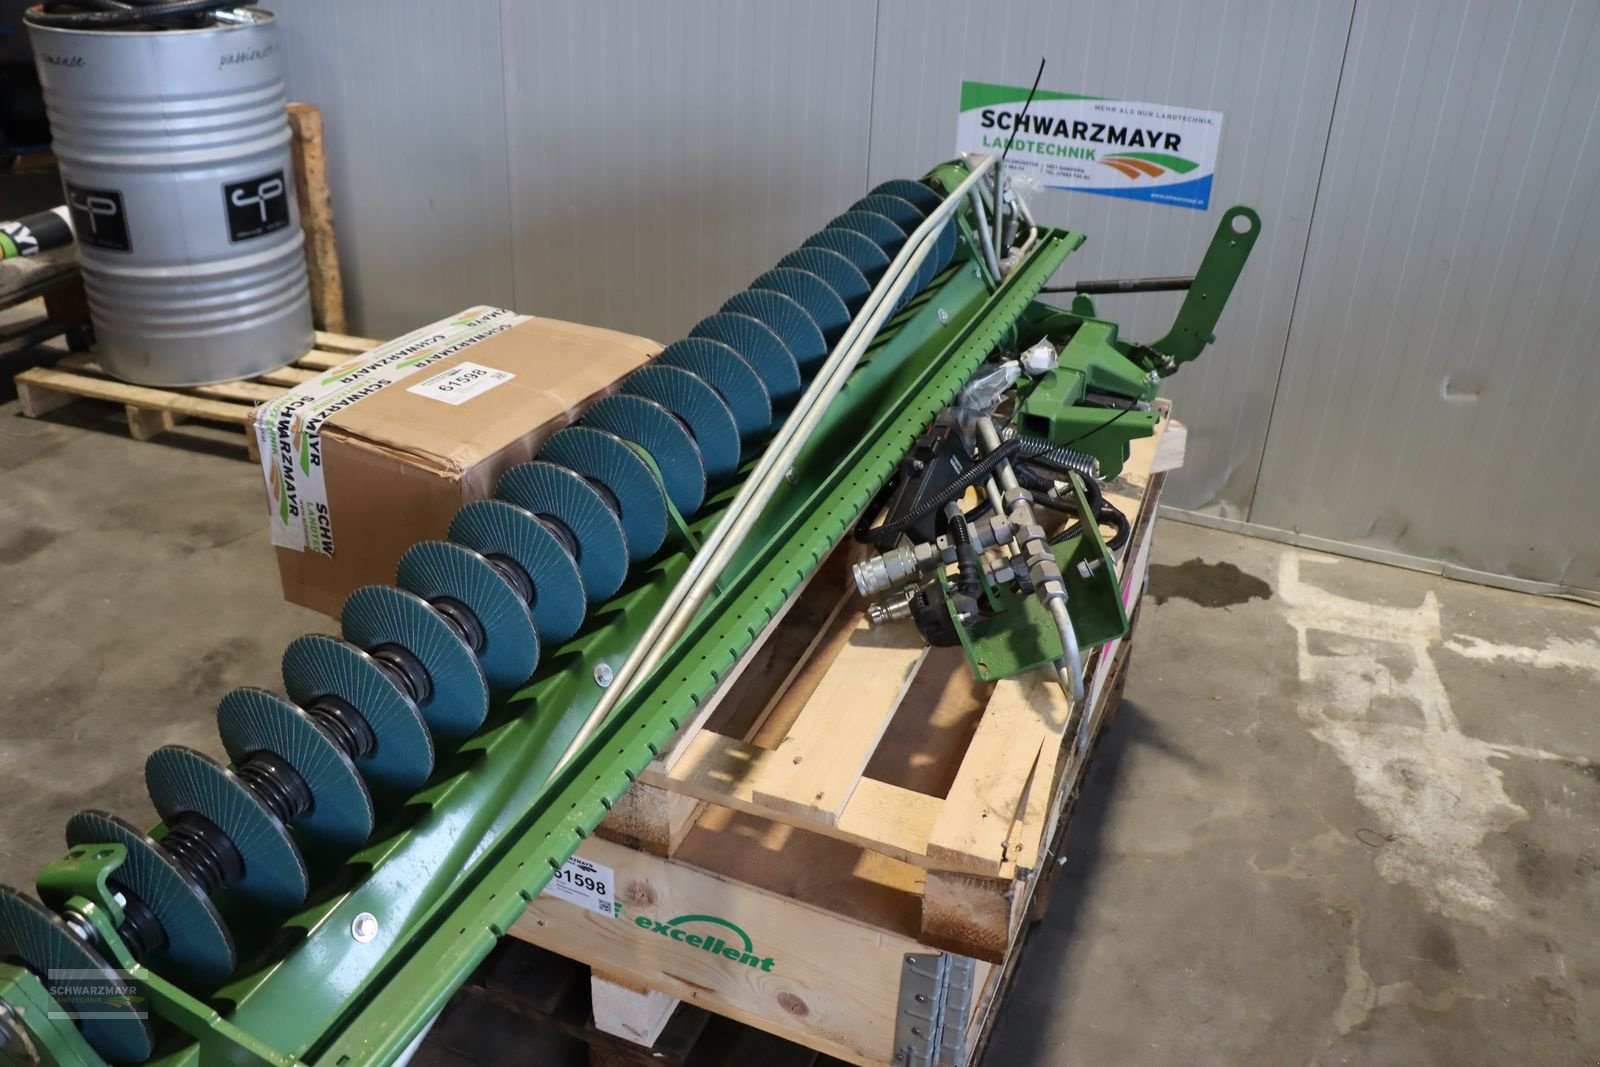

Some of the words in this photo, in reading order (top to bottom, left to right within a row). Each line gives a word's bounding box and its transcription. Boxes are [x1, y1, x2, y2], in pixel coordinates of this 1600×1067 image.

[980, 109, 1182, 152] SCHWARZMAYR
[1094, 104, 1116, 113] MEHR
[1120, 108, 1134, 116] ALS
[1137, 110, 1154, 118] NUR
[982, 134, 1097, 161] LANDTECHNIK
[341, 334, 447, 384] SCHWARZMAYR
[415, 323, 513, 369] SCHWARZMAYR
[438, 368, 488, 393] 61598
[277, 395, 316, 518] SCHWARZMAYR
[315, 502, 333, 559] SCHW
[634, 915, 776, 973] excellent
